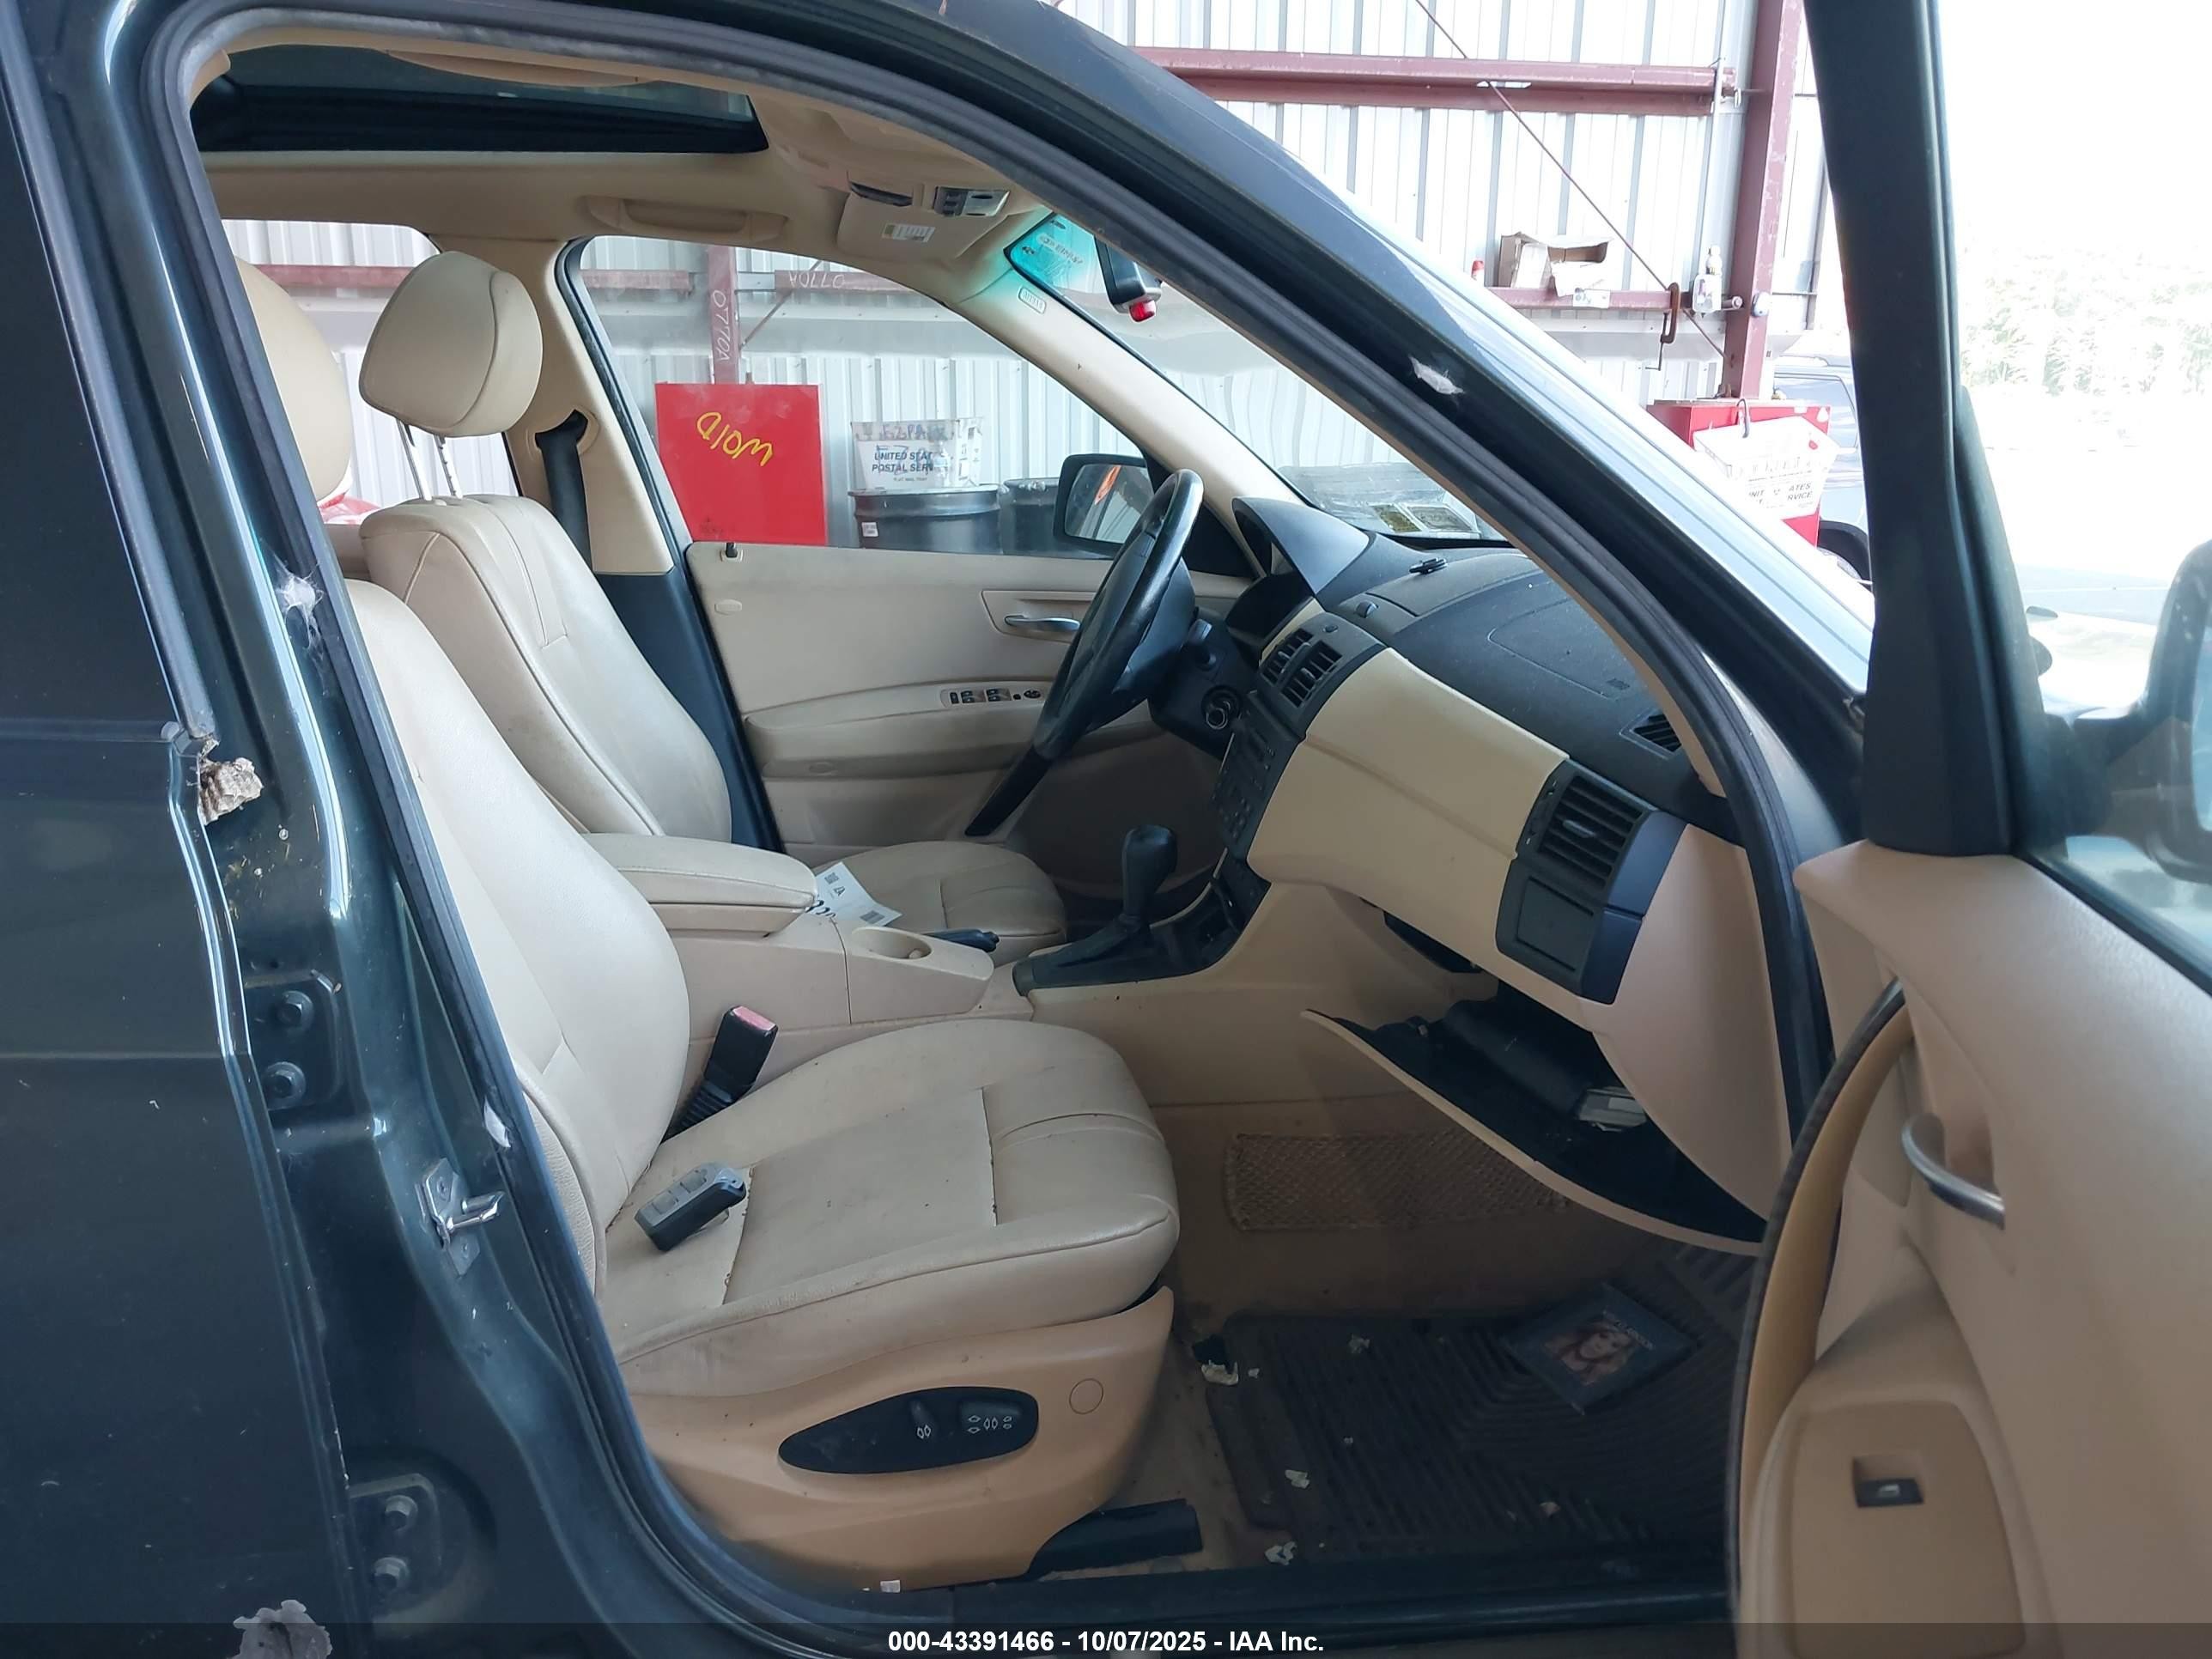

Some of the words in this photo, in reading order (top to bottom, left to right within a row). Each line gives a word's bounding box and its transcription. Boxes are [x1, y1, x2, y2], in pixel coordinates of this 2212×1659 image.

[874, 452, 908, 460] UNITED
[908, 452, 933, 460] STAT
[872, 464, 908, 472] POSTAL
[909, 464, 933, 472] SERV
[1787, 492, 1813, 501] RVICE
